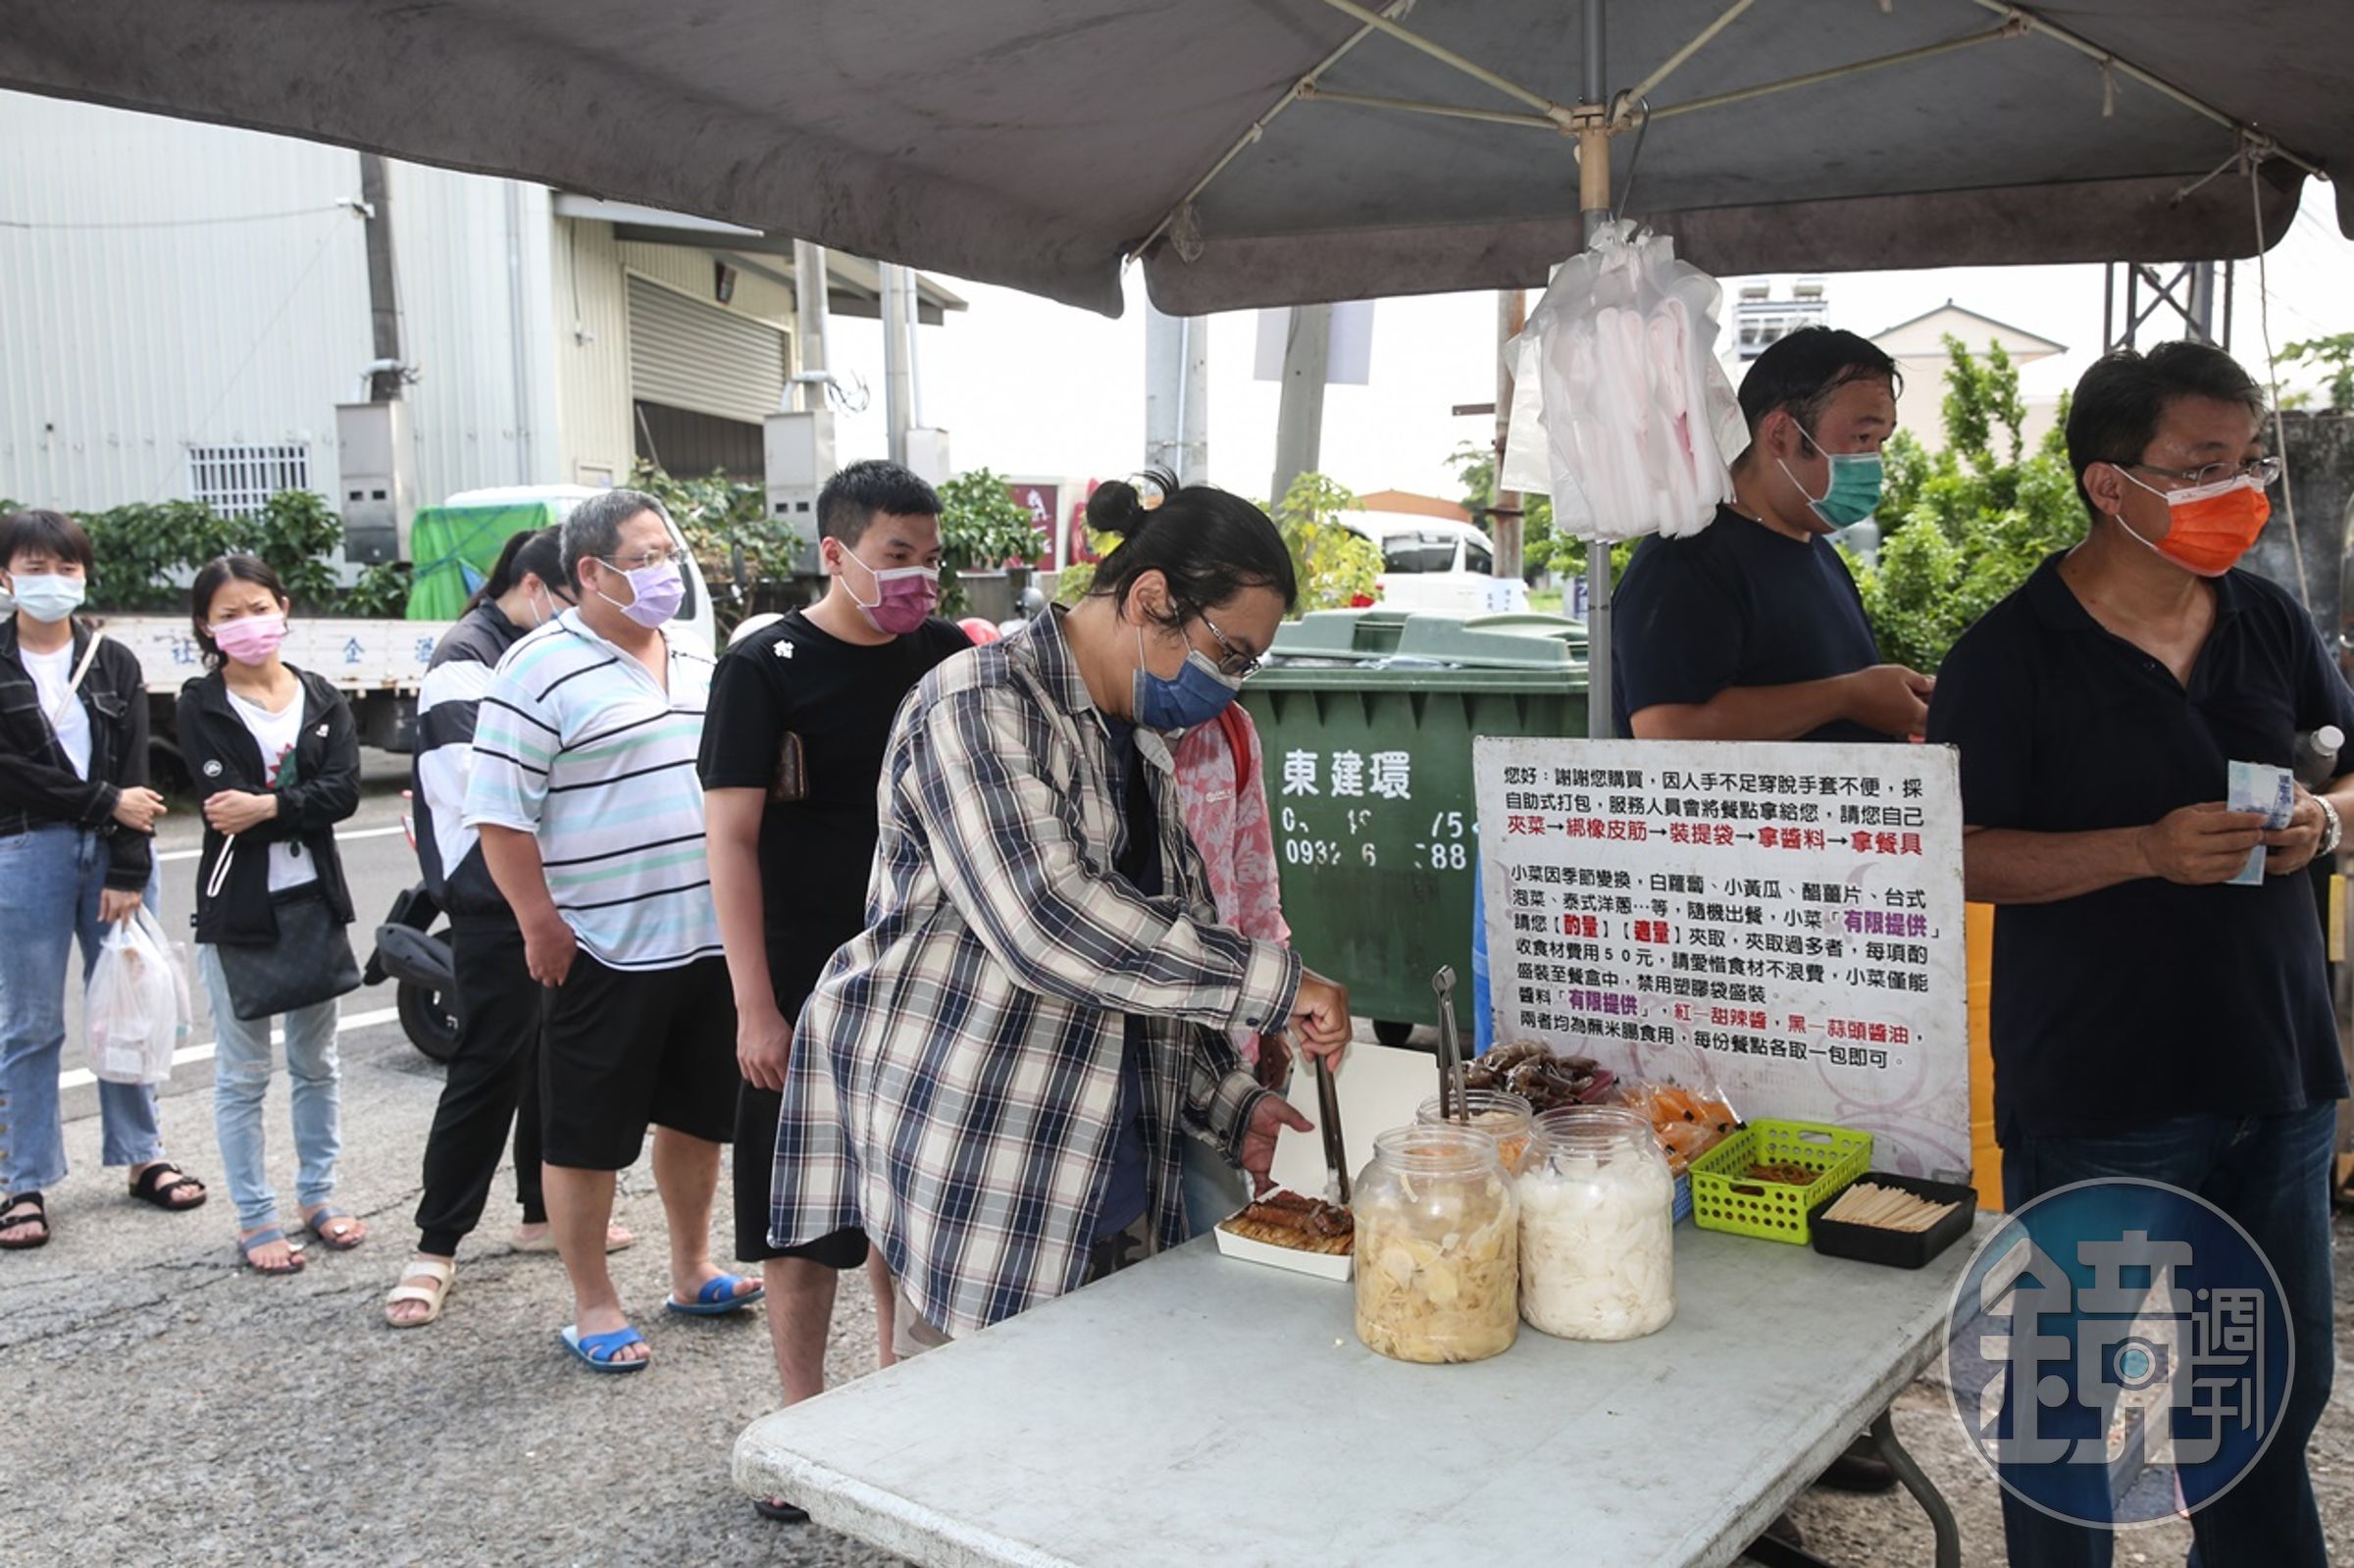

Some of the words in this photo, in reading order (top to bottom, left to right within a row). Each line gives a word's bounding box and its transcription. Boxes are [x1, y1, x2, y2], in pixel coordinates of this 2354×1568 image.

[343, 637, 365, 663] 企
[1508, 816, 1546, 835] 夾菜
[1566, 818, 1647, 841] 綁橡皮筋
[1669, 823, 1734, 846] 裝提袋
[1758, 826, 1825, 850] 拿醬料
[1851, 831, 1922, 856] 拿餐具
